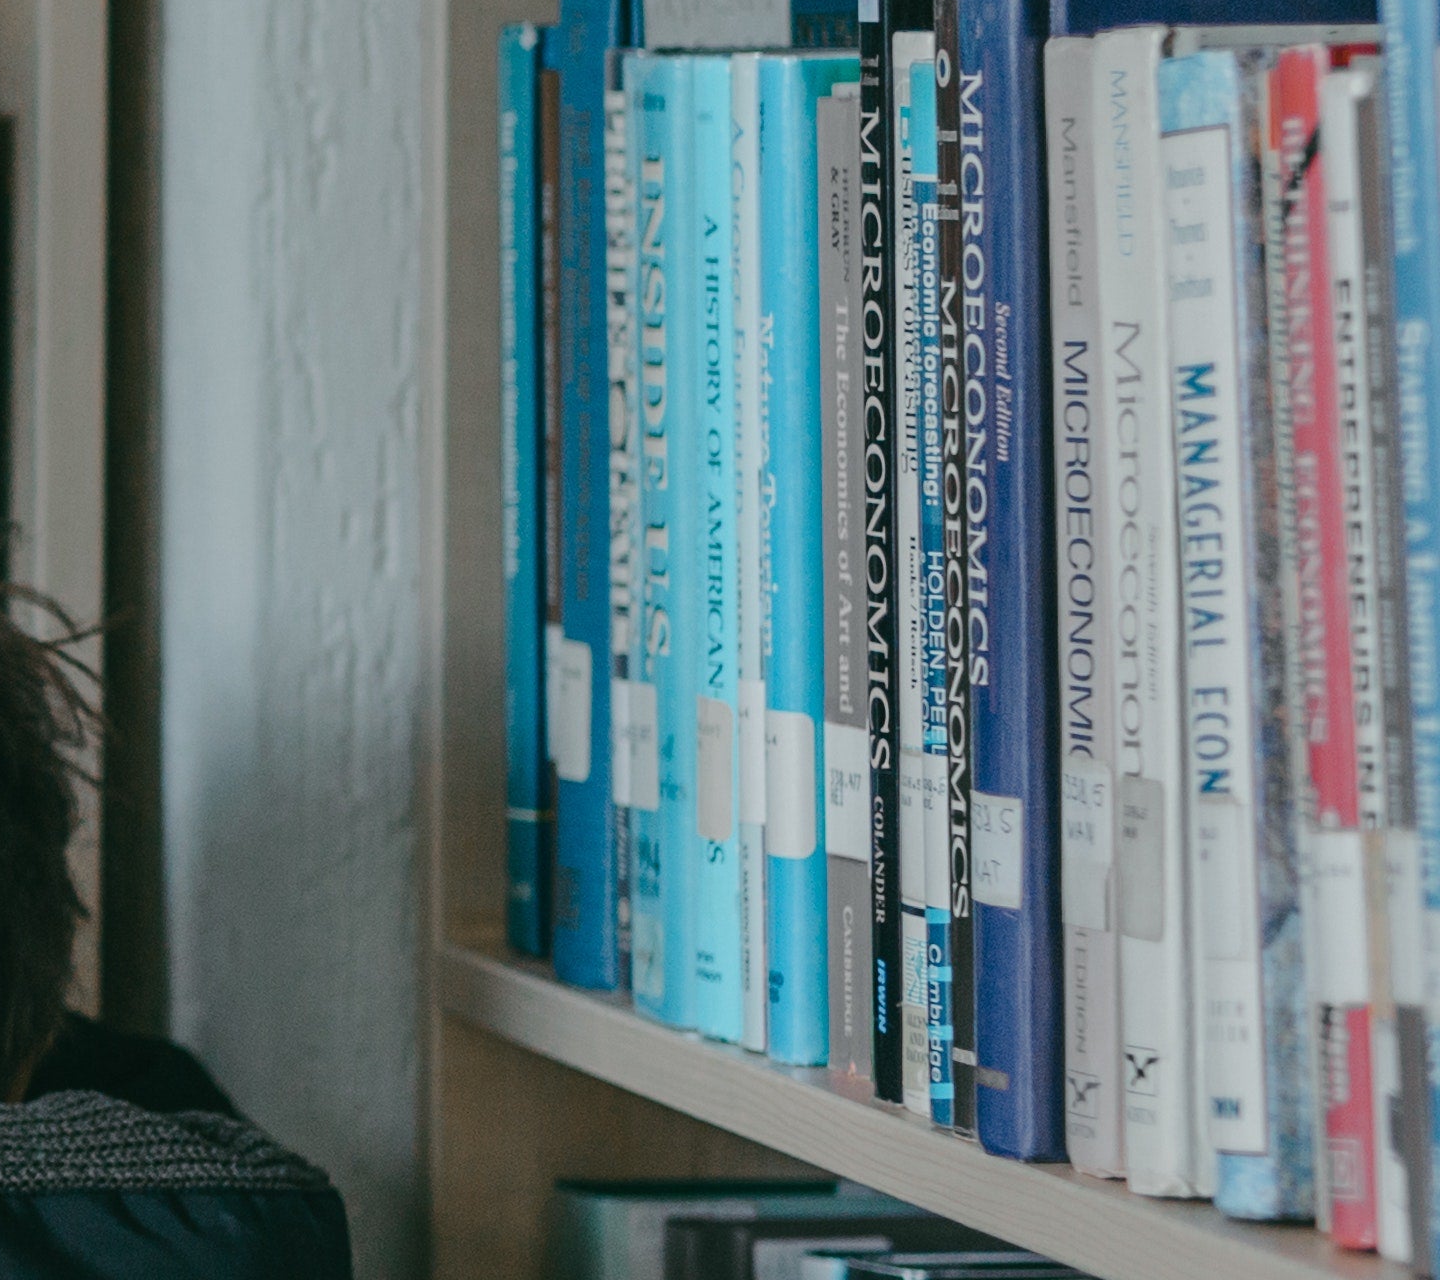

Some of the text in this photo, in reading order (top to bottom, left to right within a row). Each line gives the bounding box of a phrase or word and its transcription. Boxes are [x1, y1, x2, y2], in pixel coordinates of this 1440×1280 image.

[732, 119, 744, 144] A
[830, 166, 840, 253] & GRAY
[842, 167, 850, 284] HEILBRUN
[1060, 117, 1084, 307] Mansfield
[1109, 70, 1134, 258] MANSFIELD
[641, 153, 668, 493] INSIDE
[922, 202, 940, 507] Economic forecasting:
[960, 70, 989, 686] MICROECONOMICS
[994, 301, 1012, 462] Second Edition
[704, 214, 724, 690] A HISTORY OF AMERICAN
[759, 312, 779, 657] Nature Tourism
[836, 297, 853, 714] The Economics of Art and
[861, 107, 891, 770] MICROECONOMICS
[1174, 361, 1227, 658] MANAGERIAL
[940, 276, 969, 919] MICROECONOMICS
[1334, 279, 1376, 795] ENTREPRENEURS IN
[1147, 623, 1159, 702] Edition
[874, 796, 885, 924] COLANDER
[843, 905, 854, 1037] CAMBRIDGE
[877, 958, 887, 1033] IRWIN
[929, 943, 943, 1083] Cambridge
